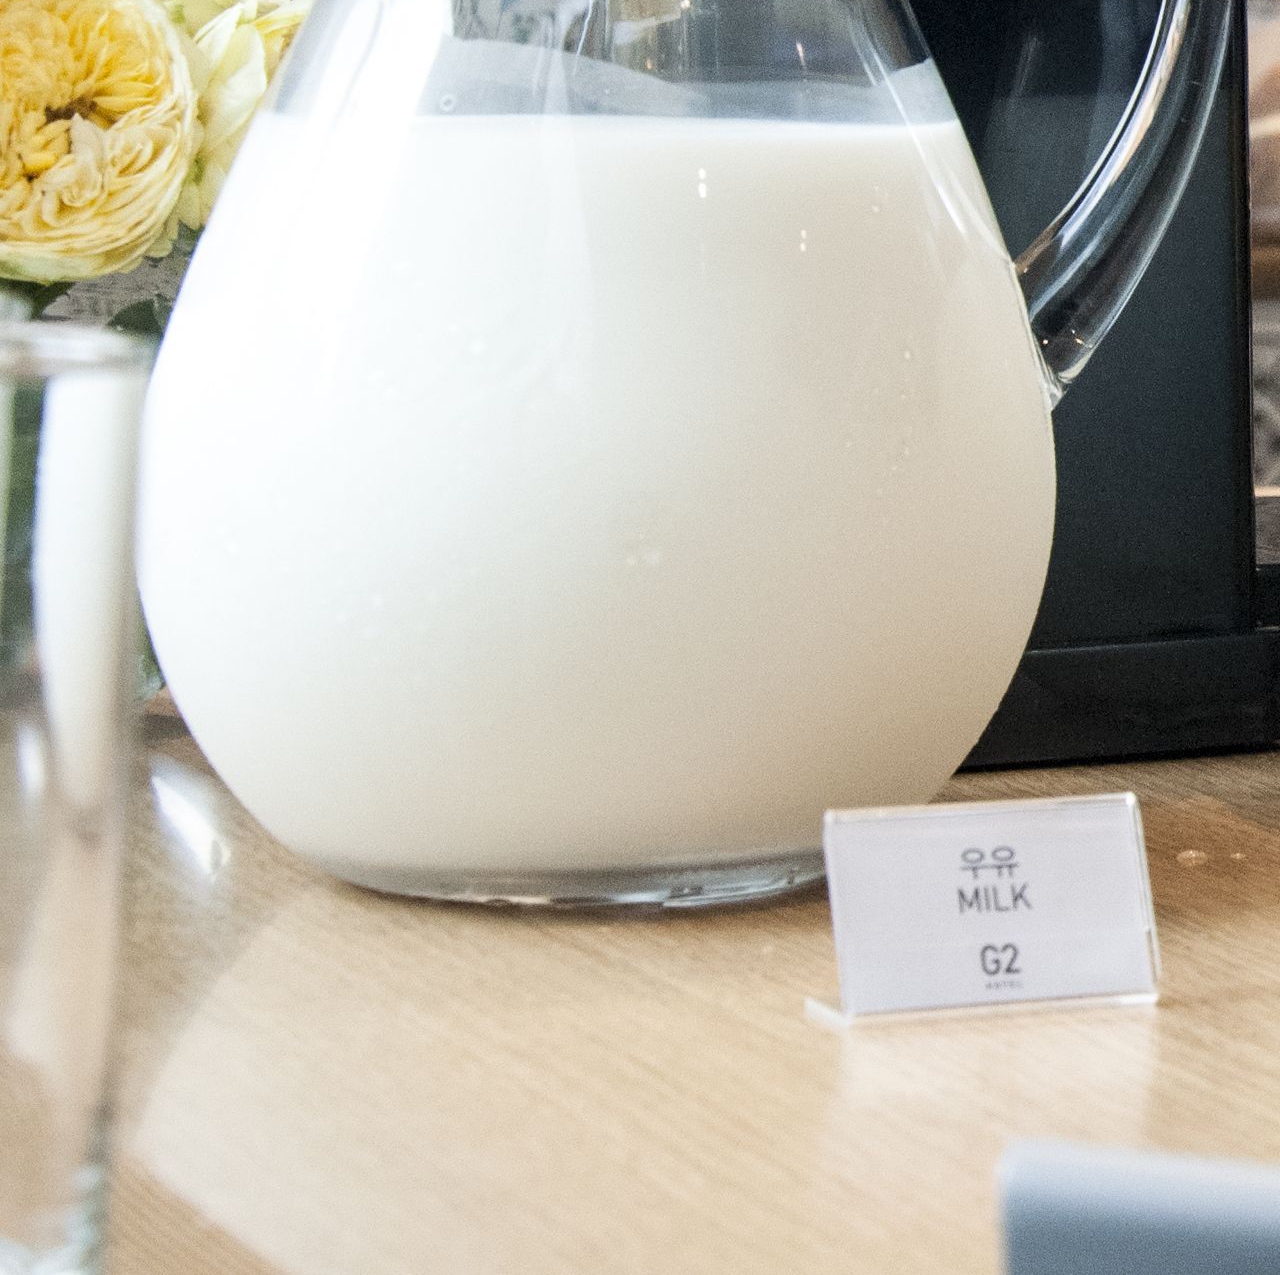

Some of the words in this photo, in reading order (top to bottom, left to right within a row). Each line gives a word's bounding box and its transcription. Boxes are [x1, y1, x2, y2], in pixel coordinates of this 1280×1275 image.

[961, 846, 1019, 879] 우유
[957, 883, 1032, 913] MILK
[980, 943, 1021, 976] G2
